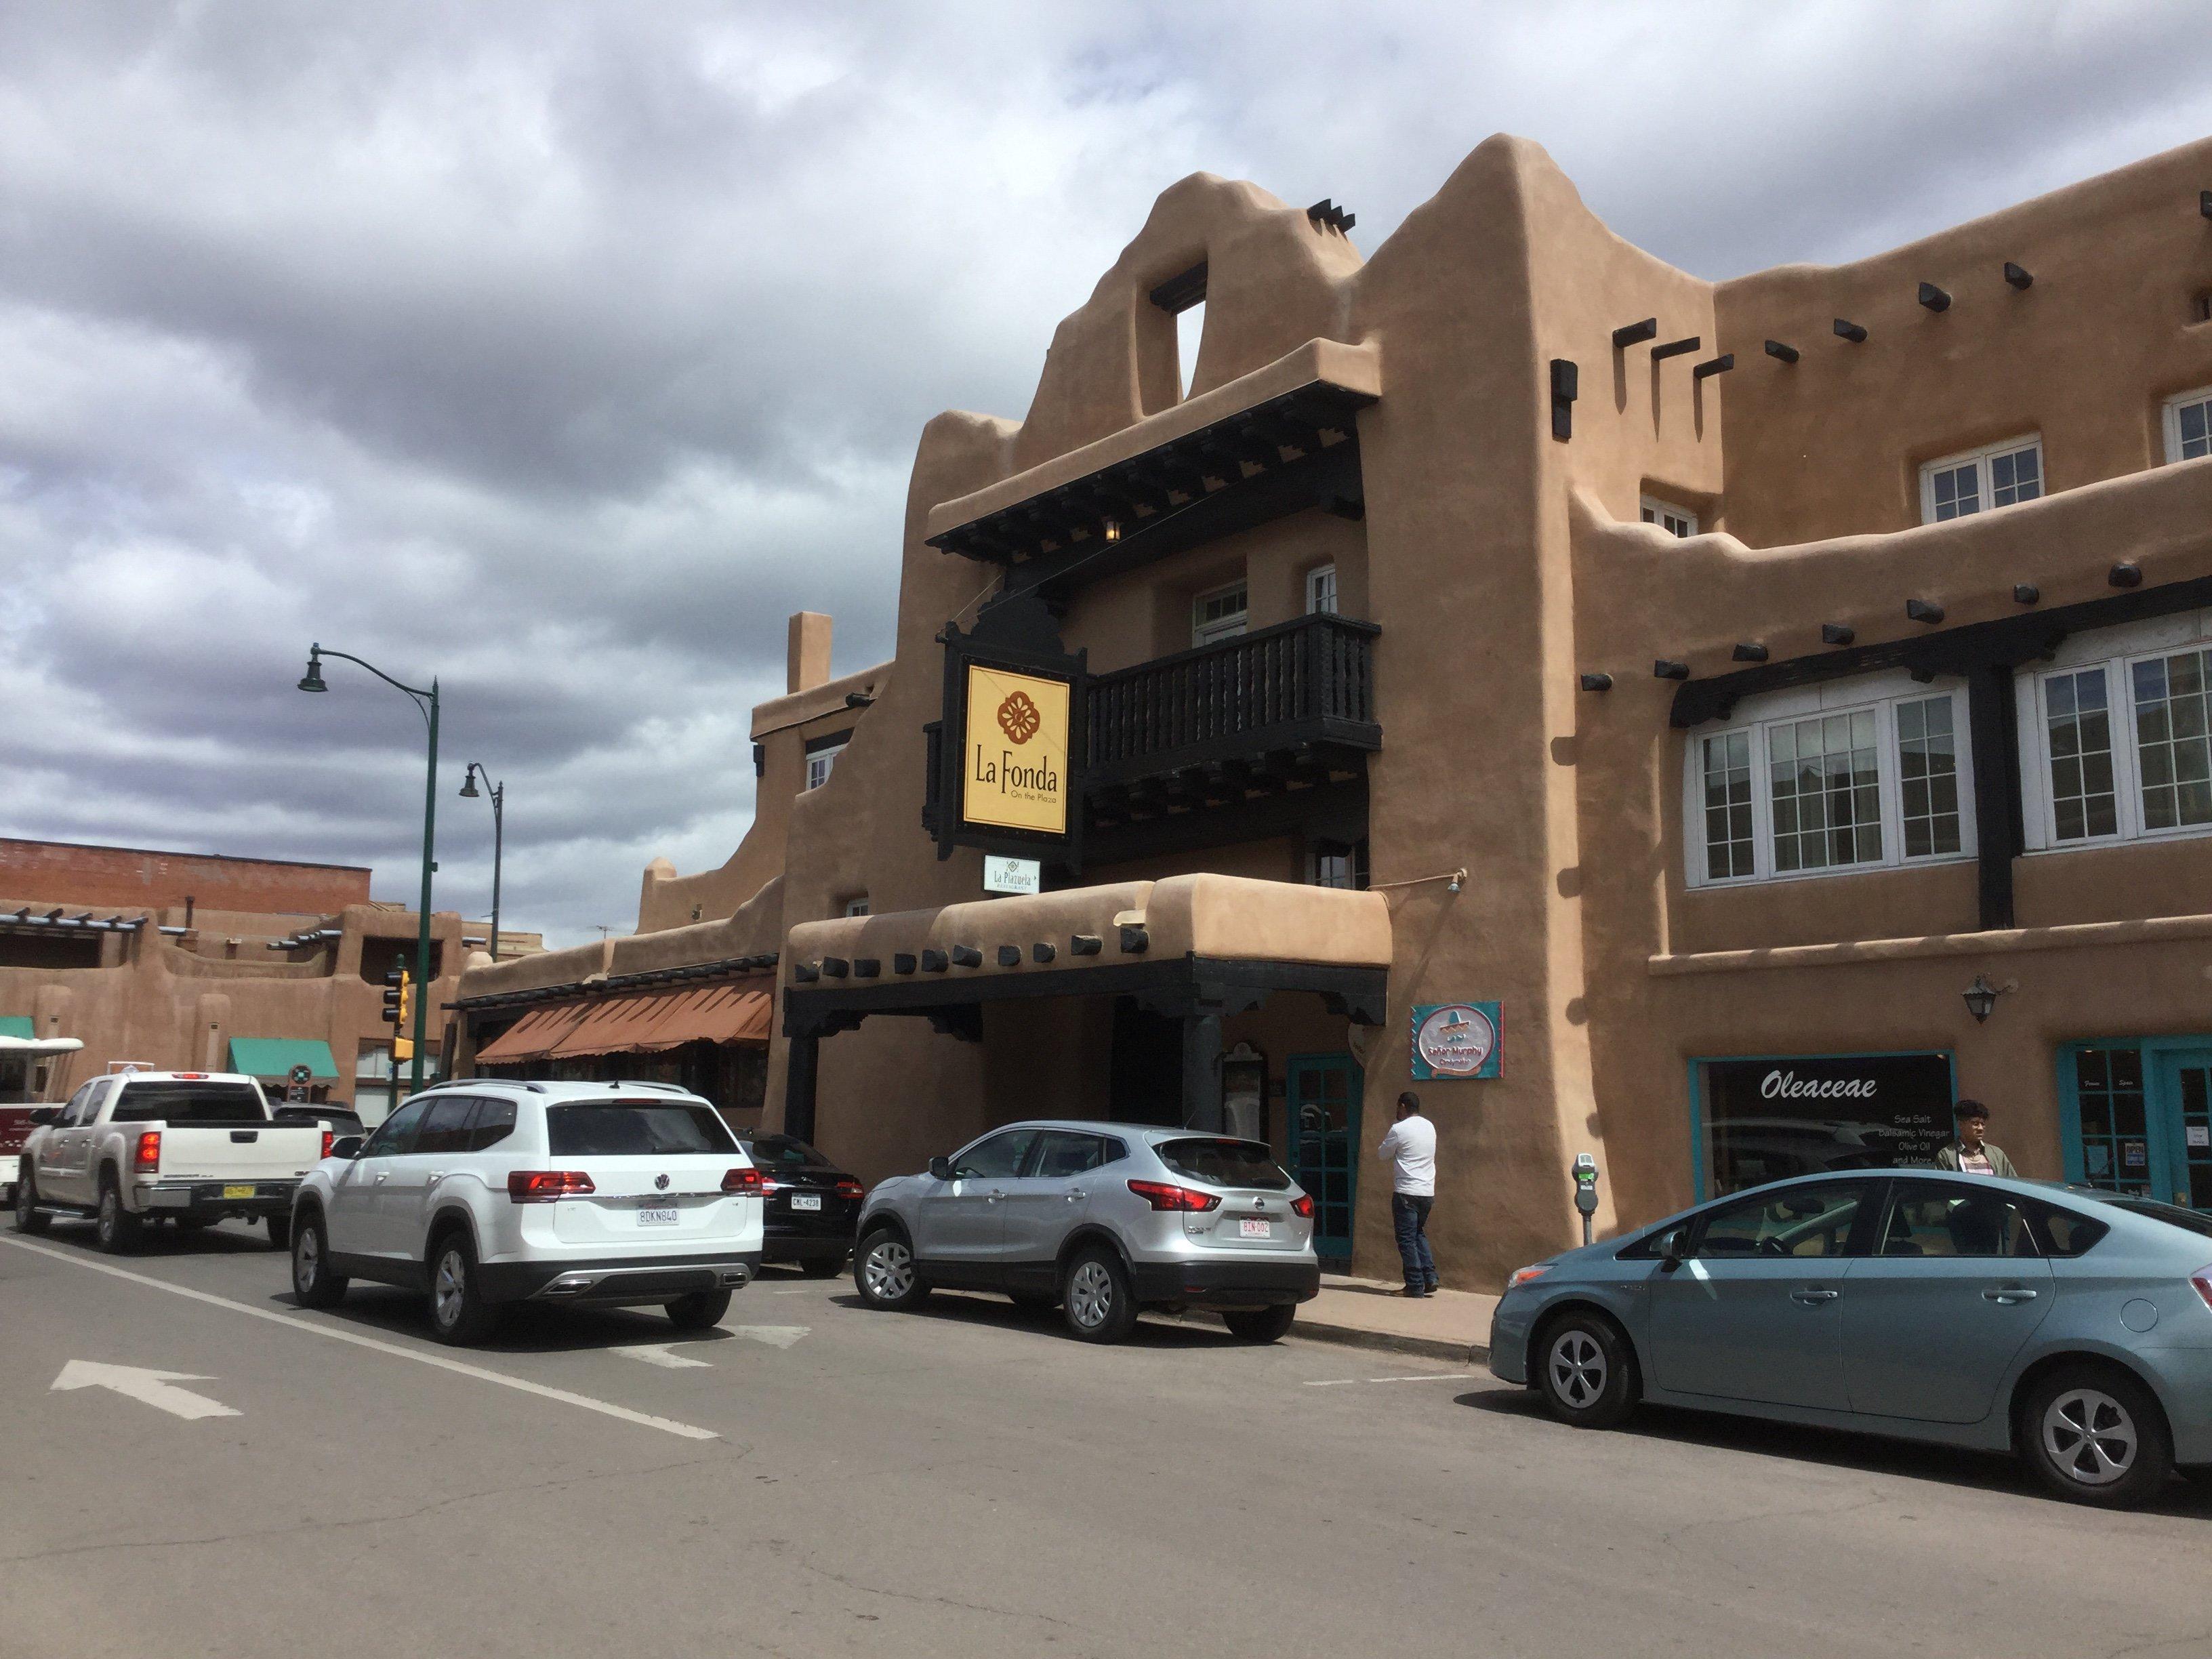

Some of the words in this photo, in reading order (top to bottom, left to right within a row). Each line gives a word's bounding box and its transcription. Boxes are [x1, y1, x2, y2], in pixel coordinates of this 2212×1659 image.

[976, 744, 996, 783] La
[1001, 750, 1057, 794] Fonda
[1010, 790, 1022, 799] On
[1025, 792, 1035, 800] the
[1038, 794, 1057, 804] Plaza
[994, 871, 1001, 882] La
[1004, 872, 1031, 886] Plazuela
[1452, 1046, 1483, 1057] Murphy
[1761, 1069, 1877, 1099] Oleaceae
[1894, 1115, 1910, 1124] Sea
[1913, 1115, 1931, 1124] Salt
[1878, 1128, 1917, 1139] Balsamic
[1919, 1128, 1950, 1139] Vinegar
[1898, 1141, 1918, 1151] Olive
[1919, 1141, 1931, 1151] Oil
[1893, 1155, 1908, 1164] and
[640, 1210, 677, 1222] 8DKN840
